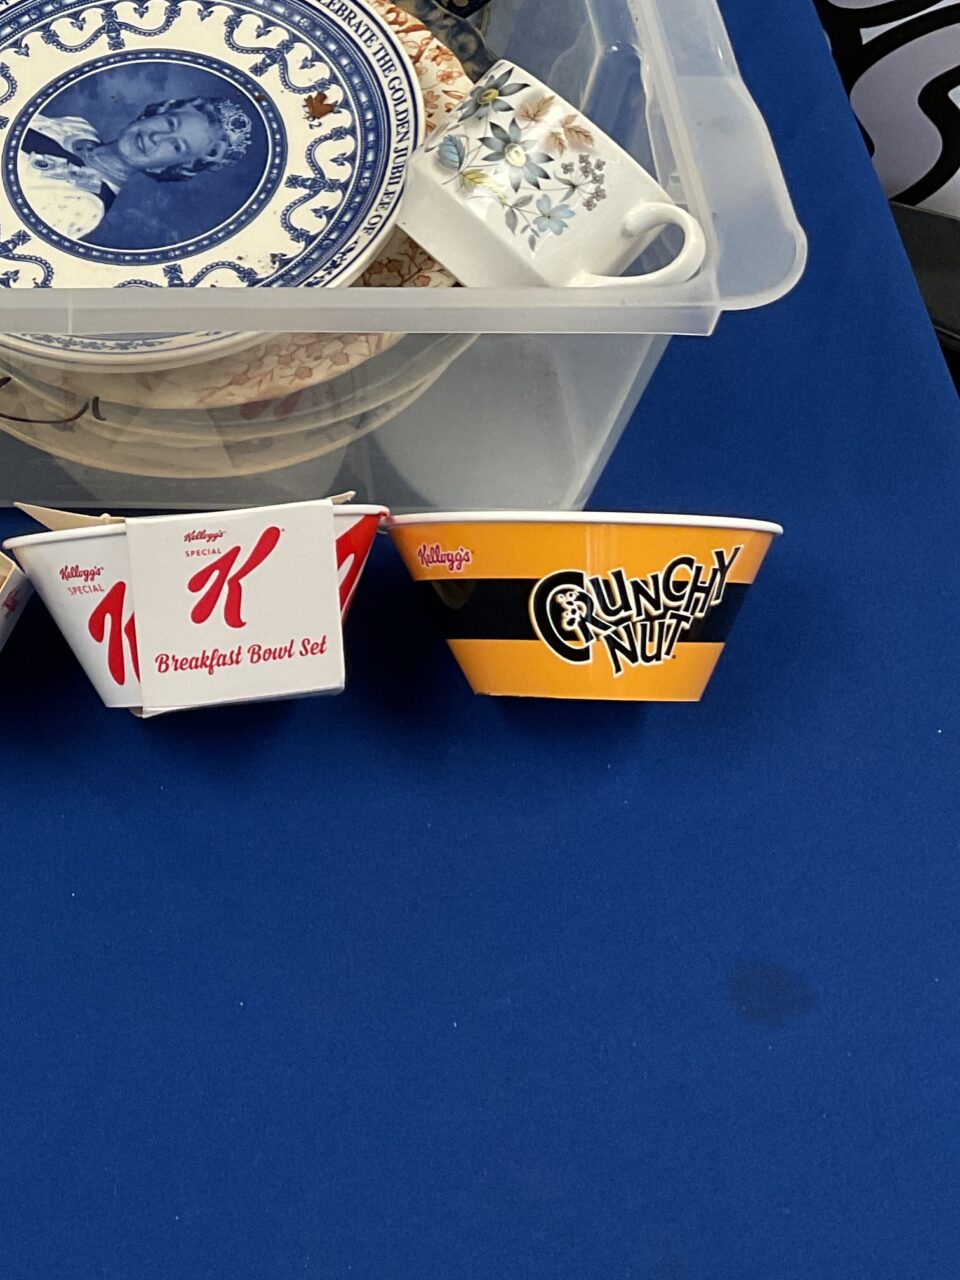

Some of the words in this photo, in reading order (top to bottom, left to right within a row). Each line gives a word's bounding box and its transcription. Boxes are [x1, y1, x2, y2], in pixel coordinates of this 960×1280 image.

[372, 43, 397, 78] THE
[387, 76, 410, 142] GOLDEN
[375, 147, 409, 212] JUBILEE
[363, 214, 383, 235] OF
[183, 528, 224, 544] Kellogg's
[185, 547, 223, 558] SPECIAL
[59, 564, 102, 582] Kellogg's
[417, 543, 474, 573] Kellogg's
[67, 583, 105, 596] SPECIAL
[187, 526, 281, 629] K
[529, 544, 745, 666] CRUNCHY
[155, 645, 242, 676] Breakfast
[247, 638, 295, 665] Bowl
[298, 635, 328, 656] Set
[601, 609, 694, 679] NUT
